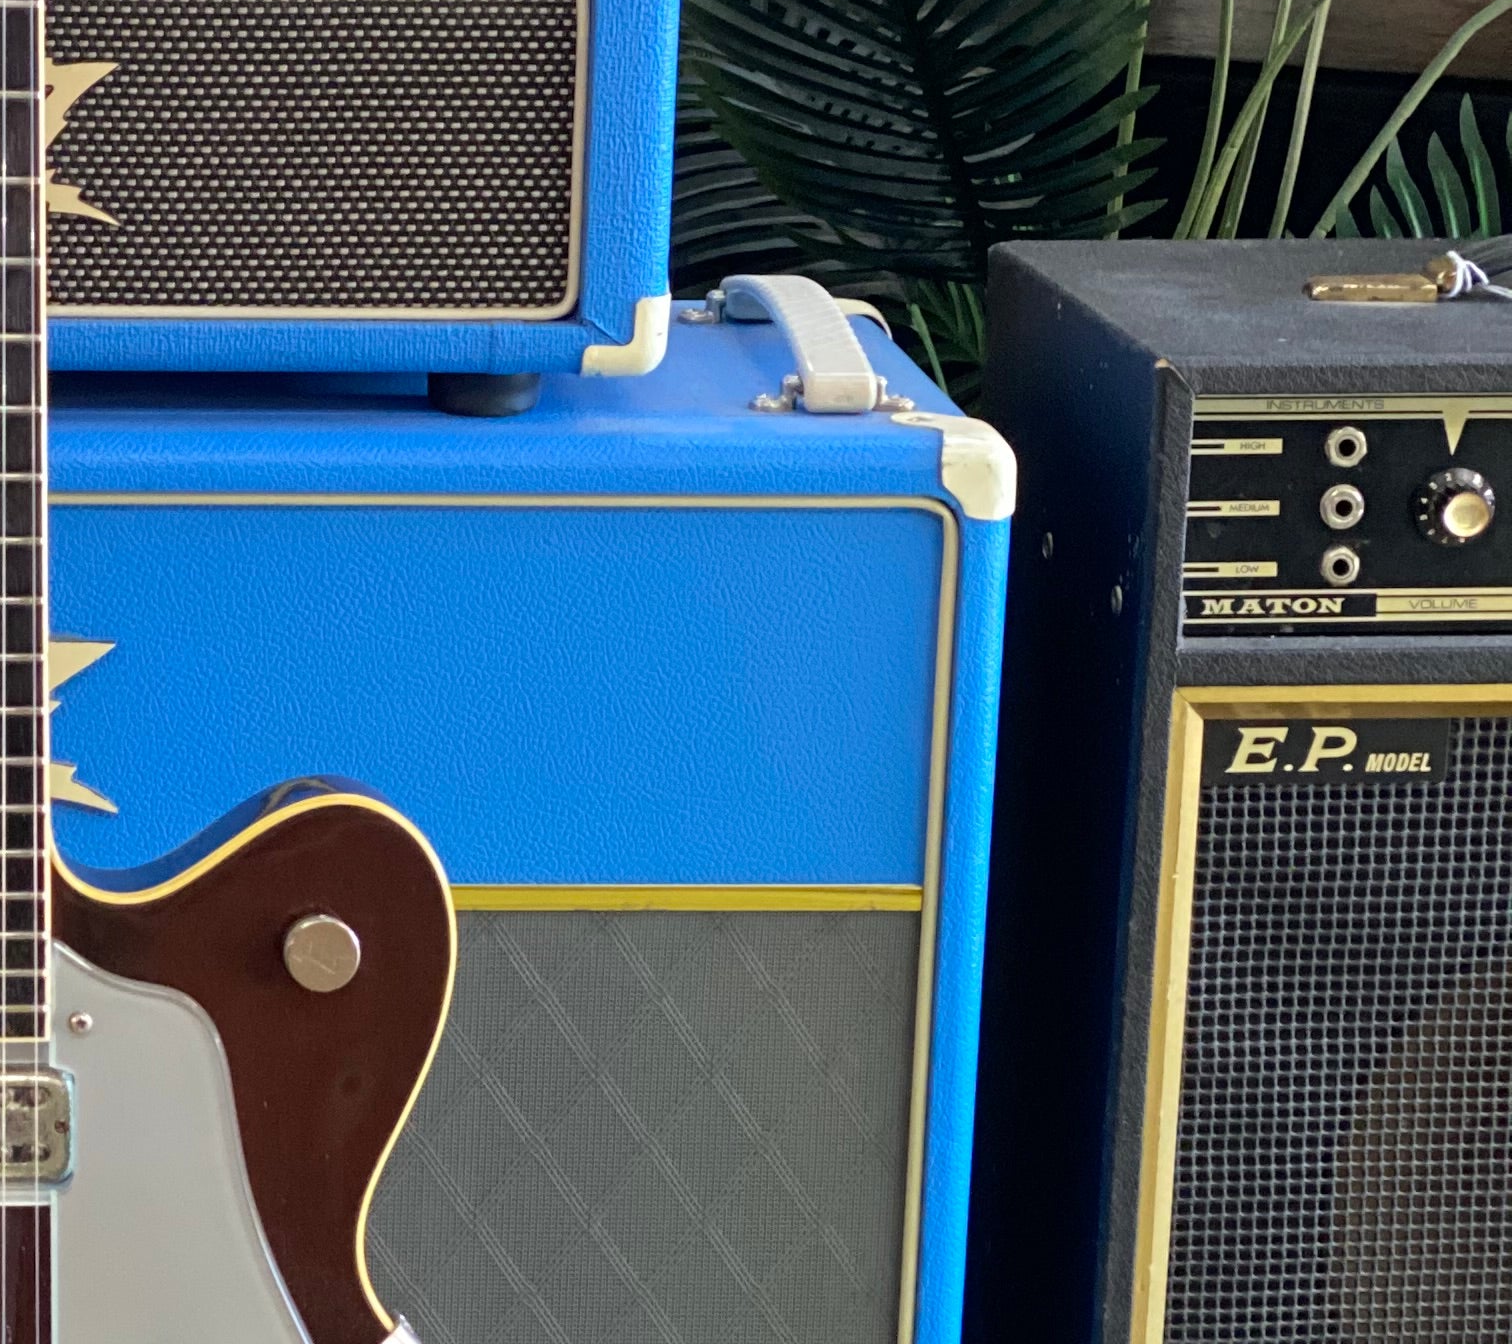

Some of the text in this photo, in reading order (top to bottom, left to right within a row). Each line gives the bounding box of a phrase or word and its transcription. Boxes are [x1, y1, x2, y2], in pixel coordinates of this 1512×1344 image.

[1265, 398, 1385, 411] INSTRUMENTS
[1239, 440, 1267, 452] HIGH
[1228, 502, 1270, 513] MEDIUM
[1234, 563, 1260, 575] LOW
[1200, 596, 1346, 616] MATON
[1407, 598, 1479, 611] VOLUME
[1224, 725, 1432, 774] E.P. MODEL
